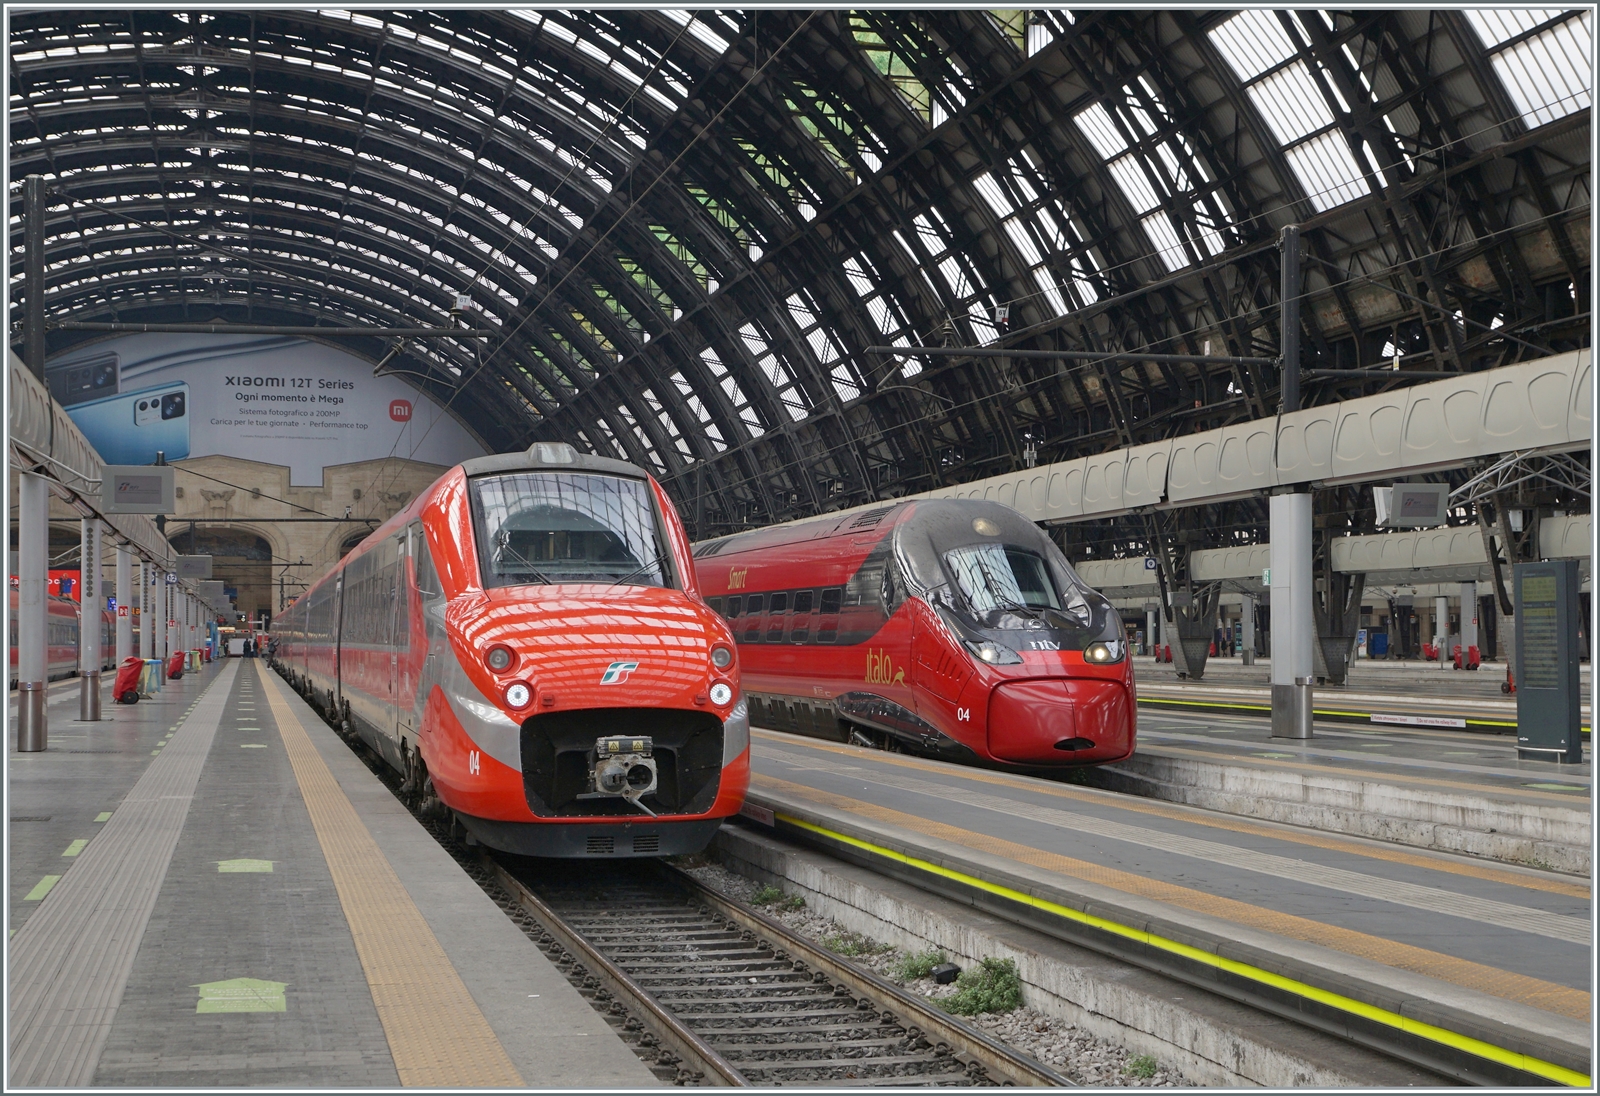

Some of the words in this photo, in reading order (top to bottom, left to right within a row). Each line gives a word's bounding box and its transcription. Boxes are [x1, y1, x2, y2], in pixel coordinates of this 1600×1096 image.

[290, 378, 312, 388] 12T
[318, 379, 354, 390] Series
[235, 392, 259, 403] Ogni
[261, 394, 308, 402] momento
[310, 394, 316, 402] è
[318, 395, 344, 405] Mega
[269, 409, 308, 417] fotografico
[269, 419, 299, 428] giornate
[309, 420, 354, 429] Performance
[356, 422, 369, 430] top
[728, 566, 748, 590] Smart
[957, 707, 970, 721] 04
[470, 750, 480, 775] 04
